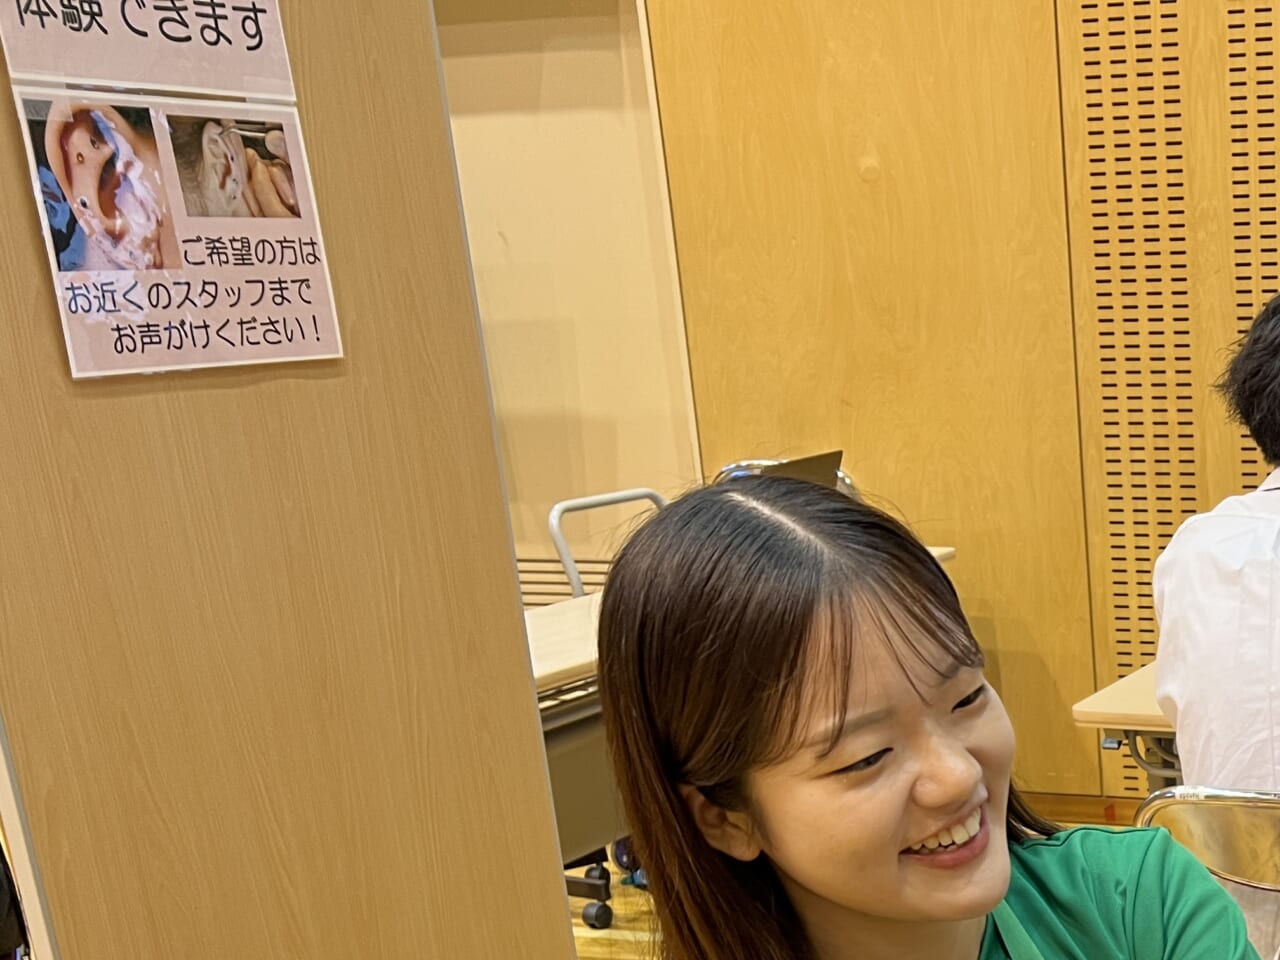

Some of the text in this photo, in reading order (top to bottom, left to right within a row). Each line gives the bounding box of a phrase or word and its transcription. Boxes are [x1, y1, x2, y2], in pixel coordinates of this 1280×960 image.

[181, 236, 321, 267] ご希望の方は
[65, 278, 314, 315] お近くのスタッフまで
